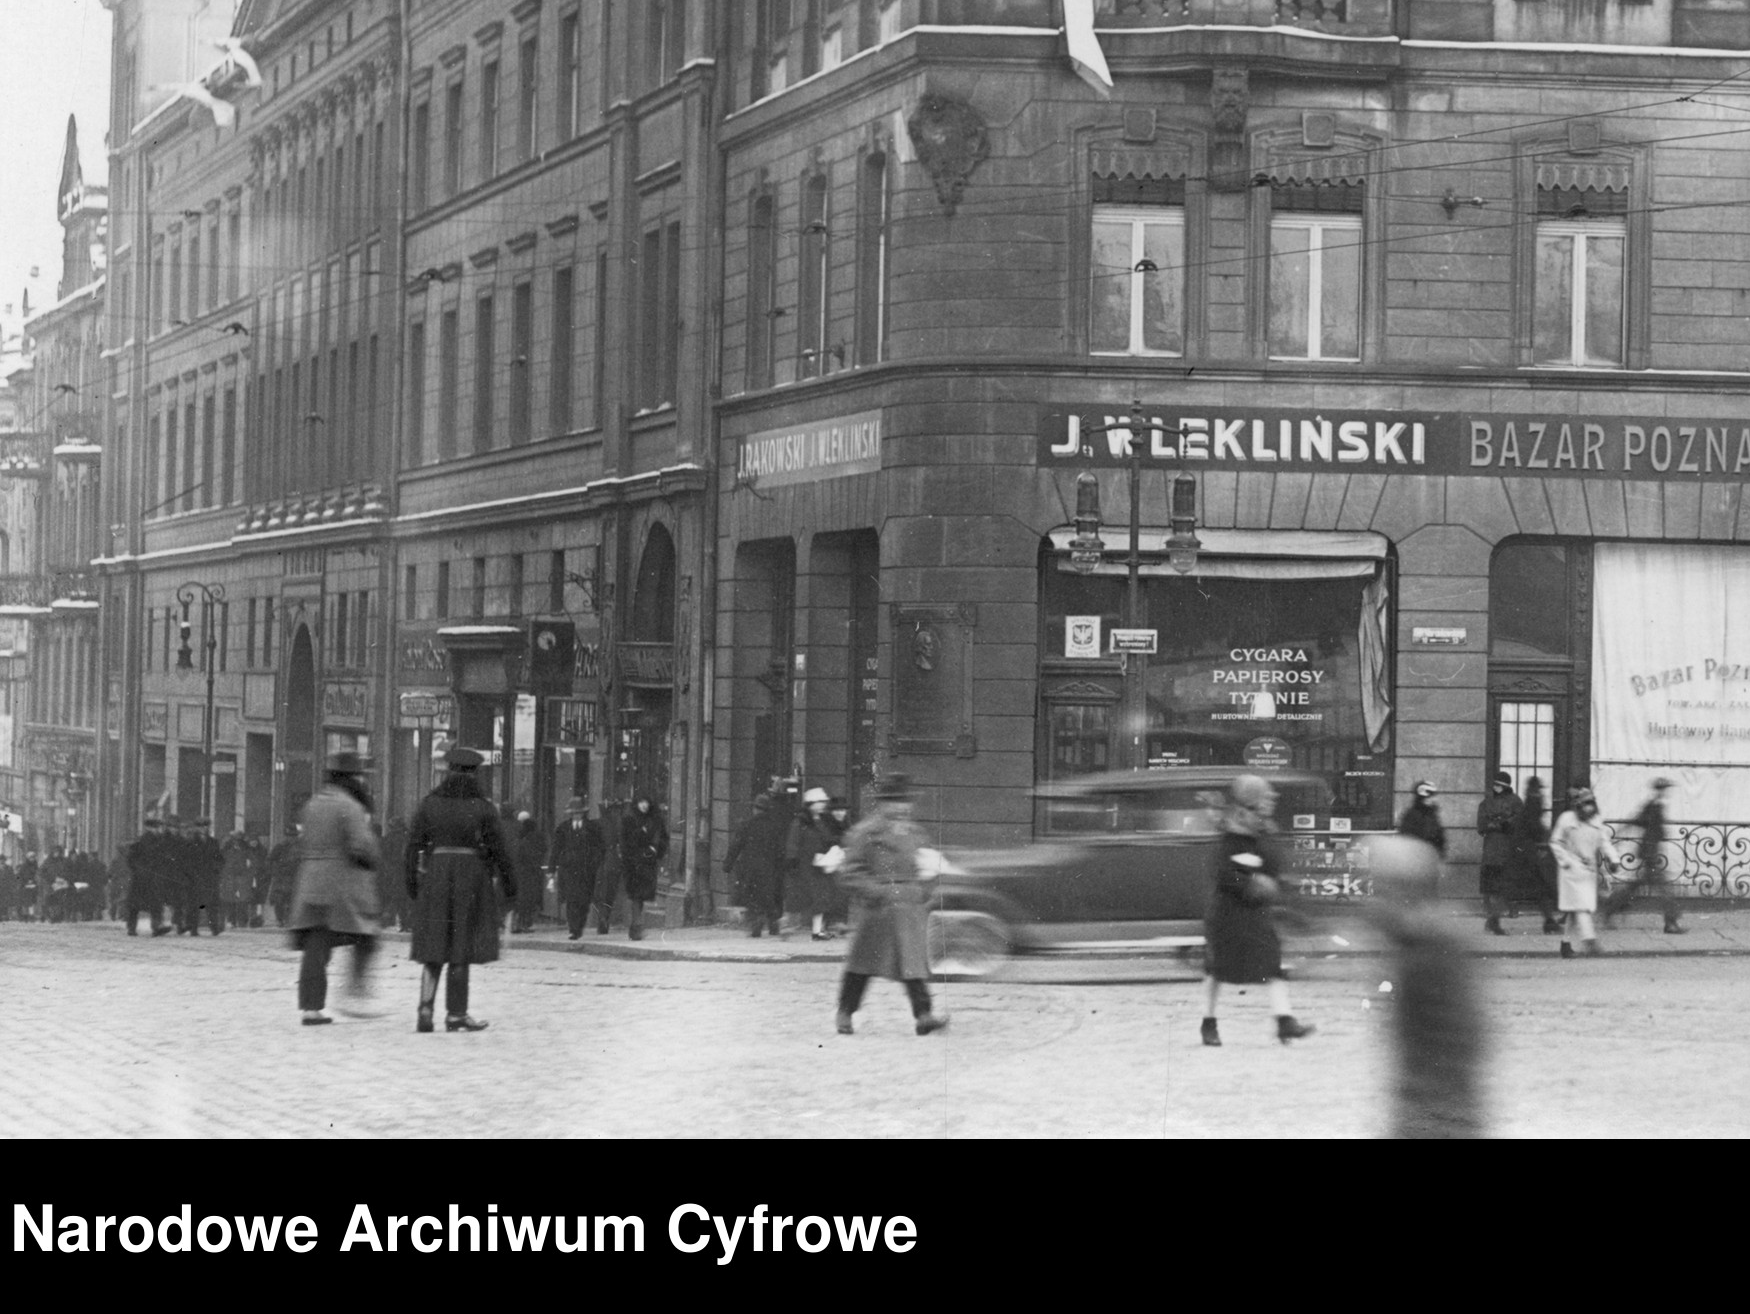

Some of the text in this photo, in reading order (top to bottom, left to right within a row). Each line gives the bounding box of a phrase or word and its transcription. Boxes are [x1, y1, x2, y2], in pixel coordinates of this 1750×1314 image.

[1051, 414, 1094, 458] J.
[1470, 420, 1606, 471] BAZAR
[1230, 648, 1308, 662] CYGARA
[1213, 670, 1324, 684] PAPIEROSY
[1630, 664, 1694, 697] Bazar
[1229, 692, 1310, 705] TYTNIE
